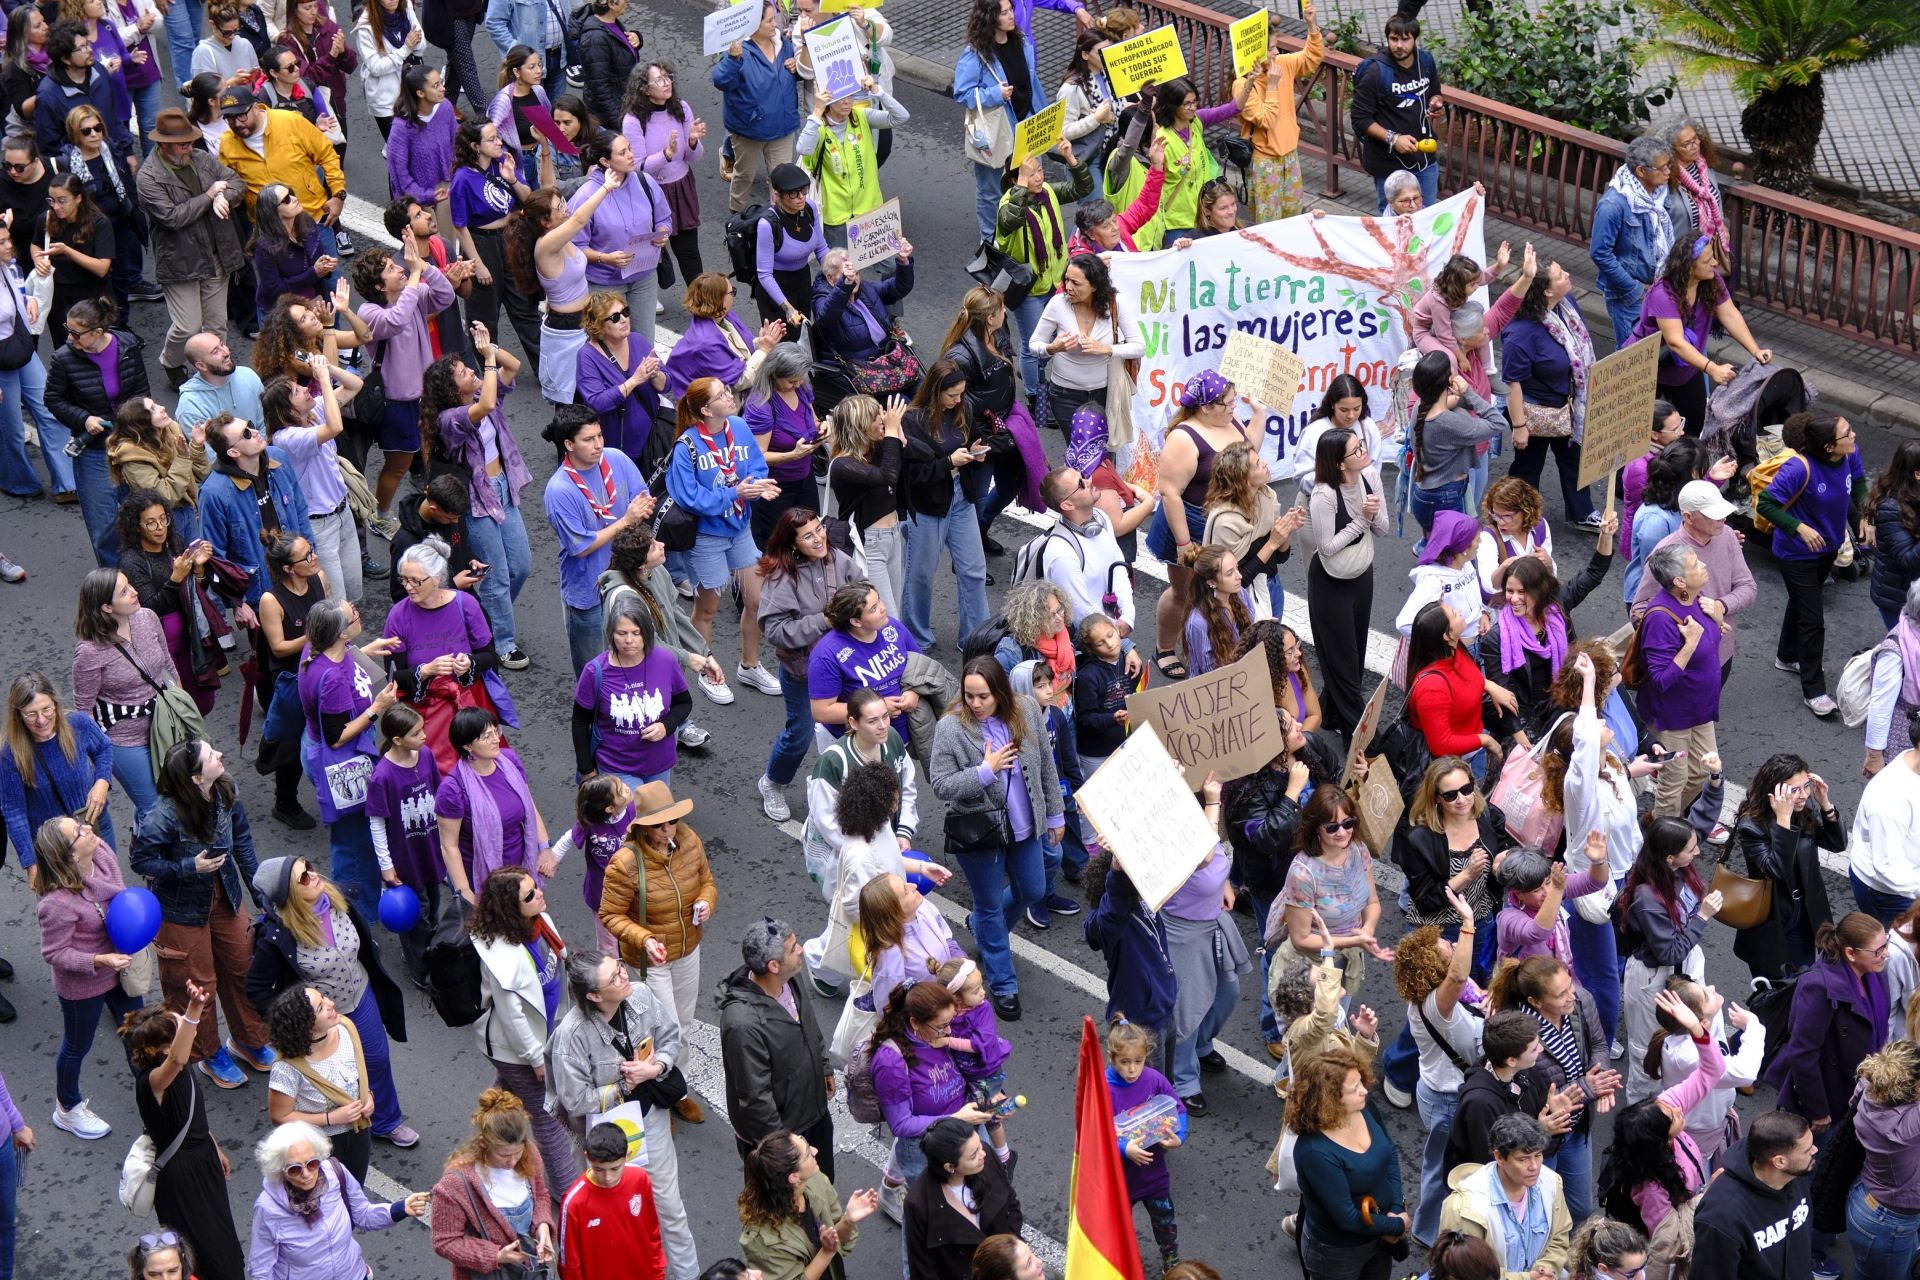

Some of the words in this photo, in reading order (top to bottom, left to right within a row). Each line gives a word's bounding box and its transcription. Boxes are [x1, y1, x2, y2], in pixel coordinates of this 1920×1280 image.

[716, 5, 754, 25] ECOFEMINISMO
[724, 20, 738, 28] PARA
[720, 20, 750, 36] ESPERANZA
[821, 38, 841, 50] futuro
[842, 34, 850, 42] es
[1124, 40, 1144, 52] ABAJO
[1145, 36, 1154, 44] EL
[816, 43, 852, 62] feminista
[1110, 40, 1173, 68] HETEROPATRIARCADO
[1122, 67, 1127, 76] Y
[1128, 59, 1152, 73] TODAS
[1154, 54, 1168, 64] SUS
[1130, 65, 1163, 82] GUERRAS
[1392, 76, 1430, 94] Reebok
[1024, 118, 1034, 129] LAS
[1036, 102, 1062, 122] MUJERES
[1026, 126, 1036, 136] NO
[1036, 114, 1057, 130] SOMOS
[1026, 128, 1046, 145] ARMAS
[1048, 122, 1055, 134] DE
[1028, 134, 1051, 152] GUERRA
[863, 226, 894, 244] CARNAVAL
[868, 244, 890, 259] LUCHA
[1140, 278, 1177, 314] Ni
[1189, 260, 1216, 311] la
[1225, 259, 1326, 312] tierra
[1182, 313, 1227, 357] las
[1236, 308, 1378, 355] mujeres
[1233, 344, 1254, 359] VIDA
[1224, 356, 1242, 368] QUE
[1272, 373, 1288, 386] PARA
[854, 654, 887, 688] NI
[876, 642, 899, 663] UNA
[884, 653, 906, 674] MÁS
[624, 682, 644, 690] Juntas
[1158, 671, 1249, 730] MUJER
